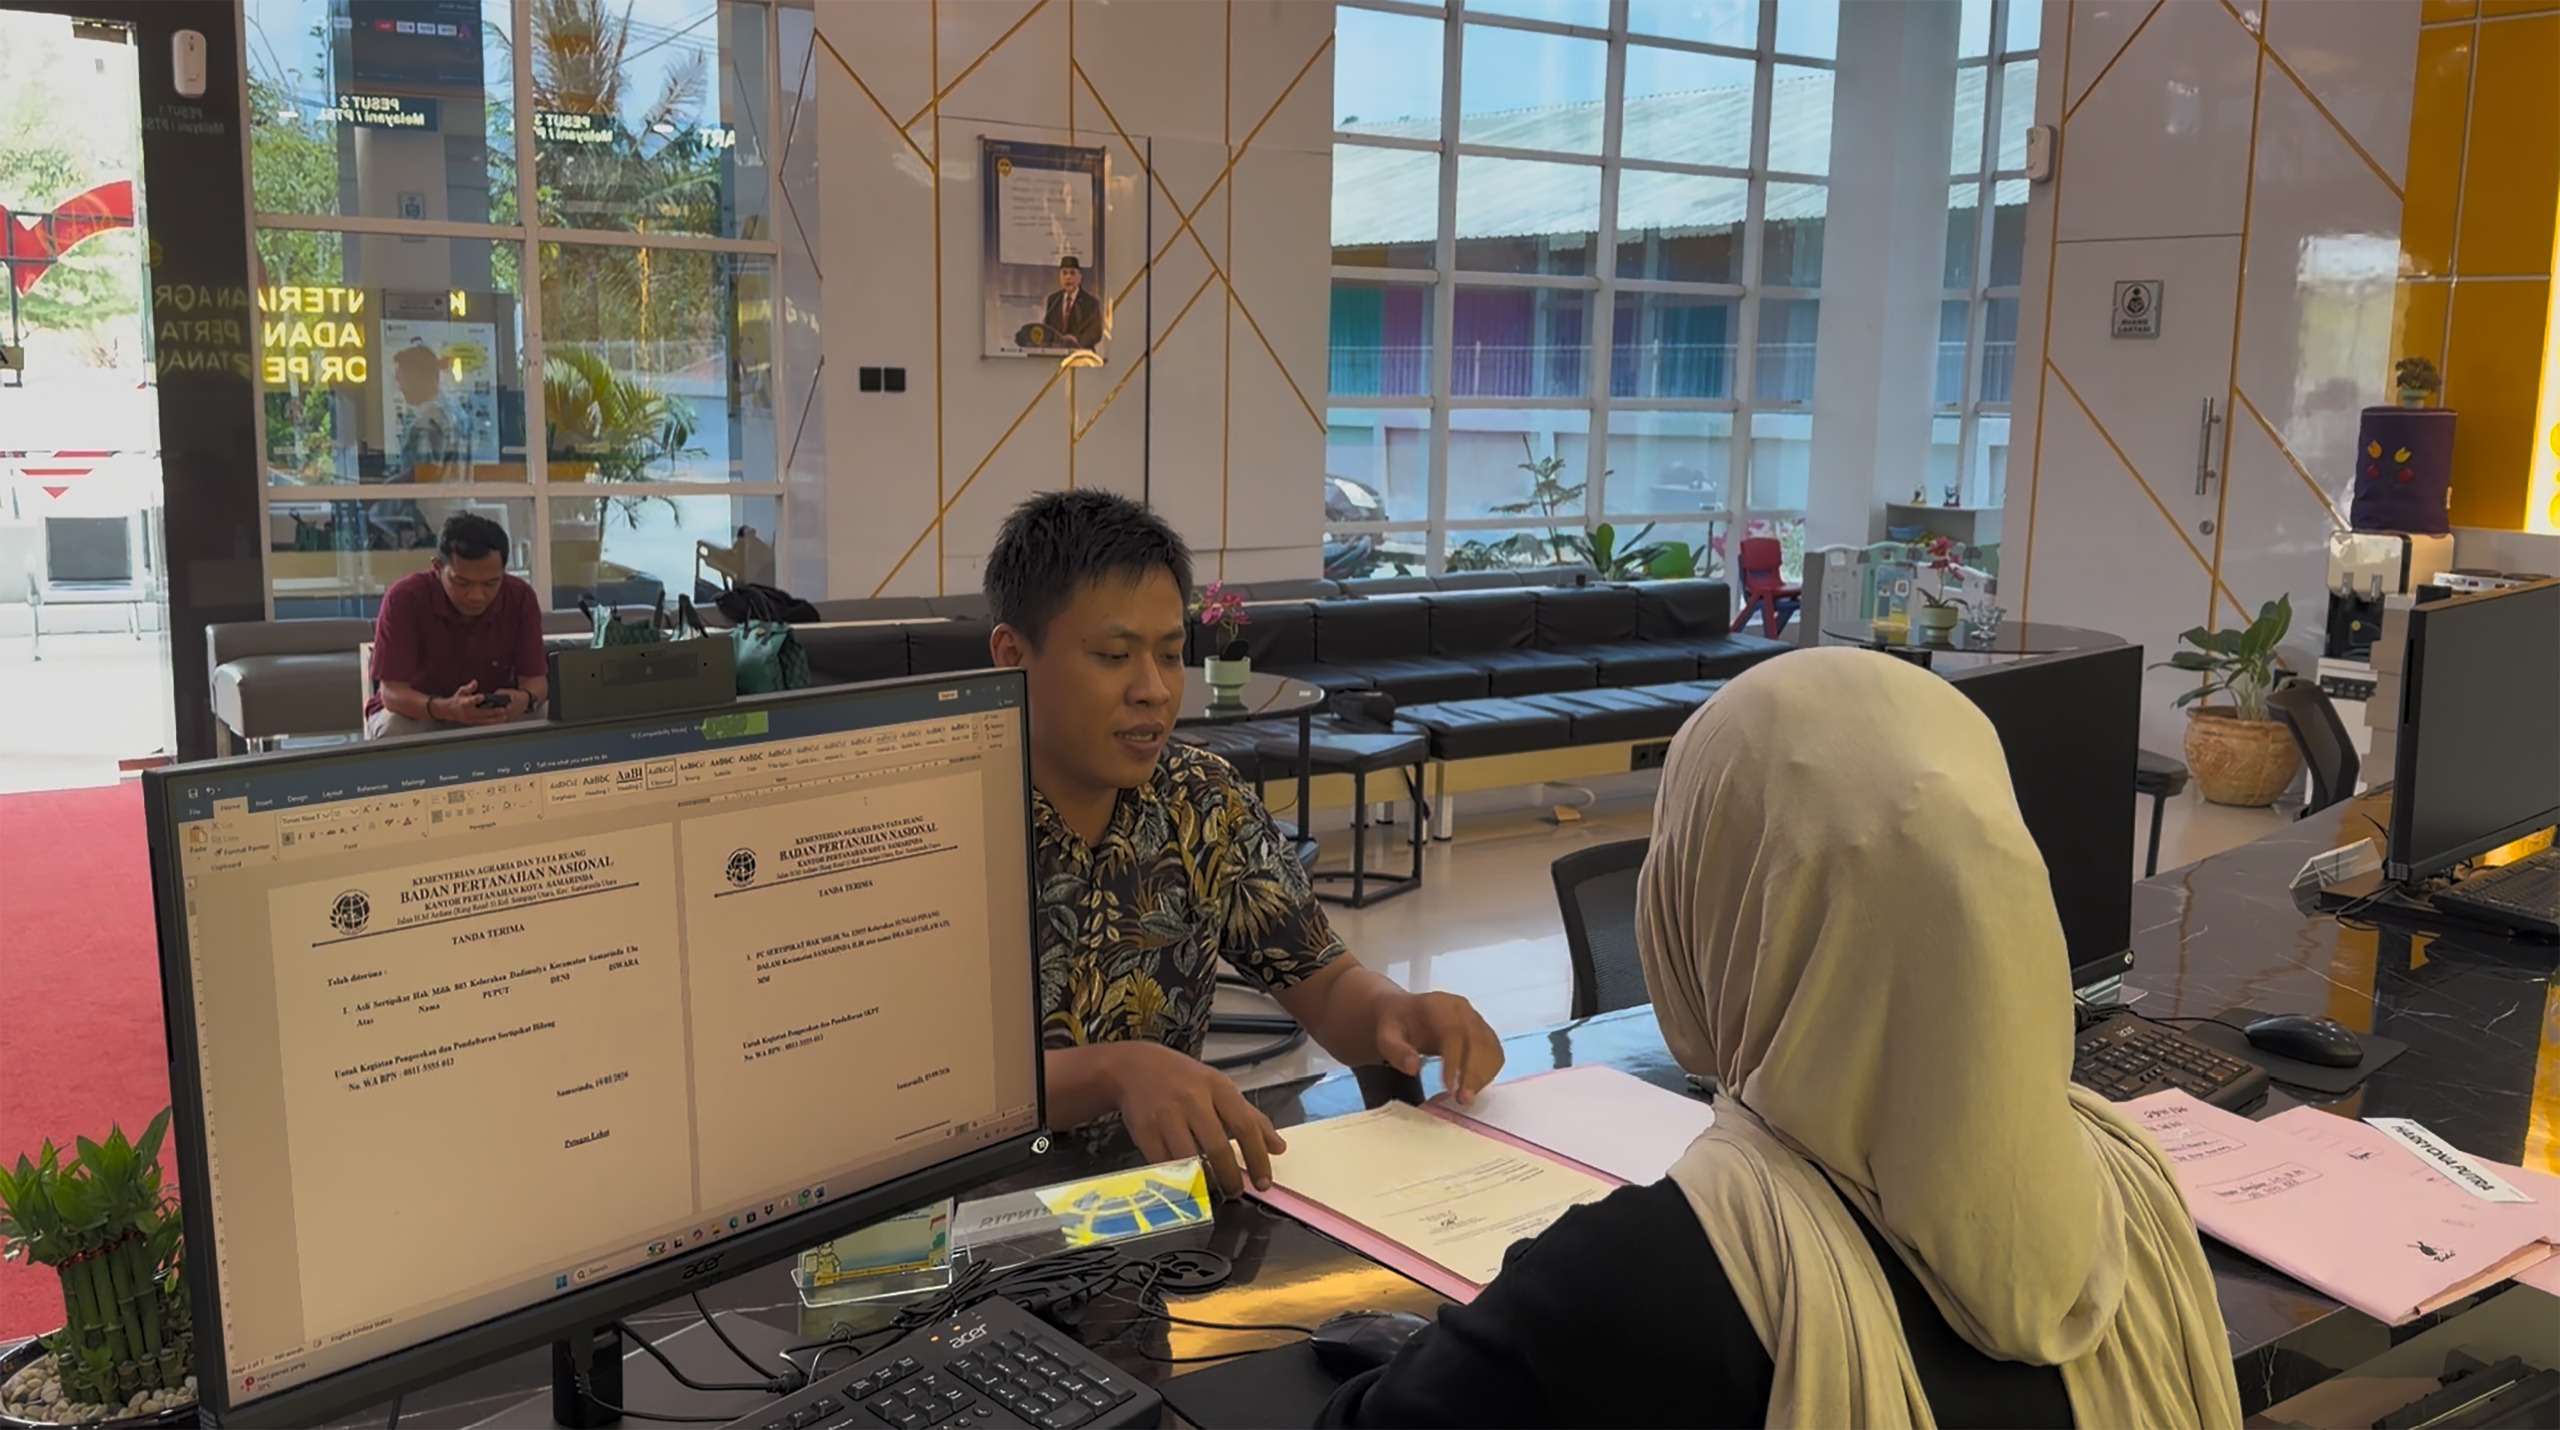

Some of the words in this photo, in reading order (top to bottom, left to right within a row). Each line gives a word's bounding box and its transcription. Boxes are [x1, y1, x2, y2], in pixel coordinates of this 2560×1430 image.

[779, 848, 817, 862] BADAN
[818, 833, 889, 854] PERTANAHAN
[889, 822, 938, 839] NASIONAL
[401, 886, 450, 904] BADAN
[453, 867, 545, 894] PERTANAHAN
[548, 855, 614, 876] NASIONAL
[412, 869, 475, 886] KEMENTERIAN
[819, 885, 844, 897] TANDA
[425, 897, 461, 911] KANTOR
[452, 931, 485, 945] TANDA
[487, 924, 525, 938] TERIMA
[683, 1253, 723, 1280] acer
[949, 1322, 989, 1349] acer
